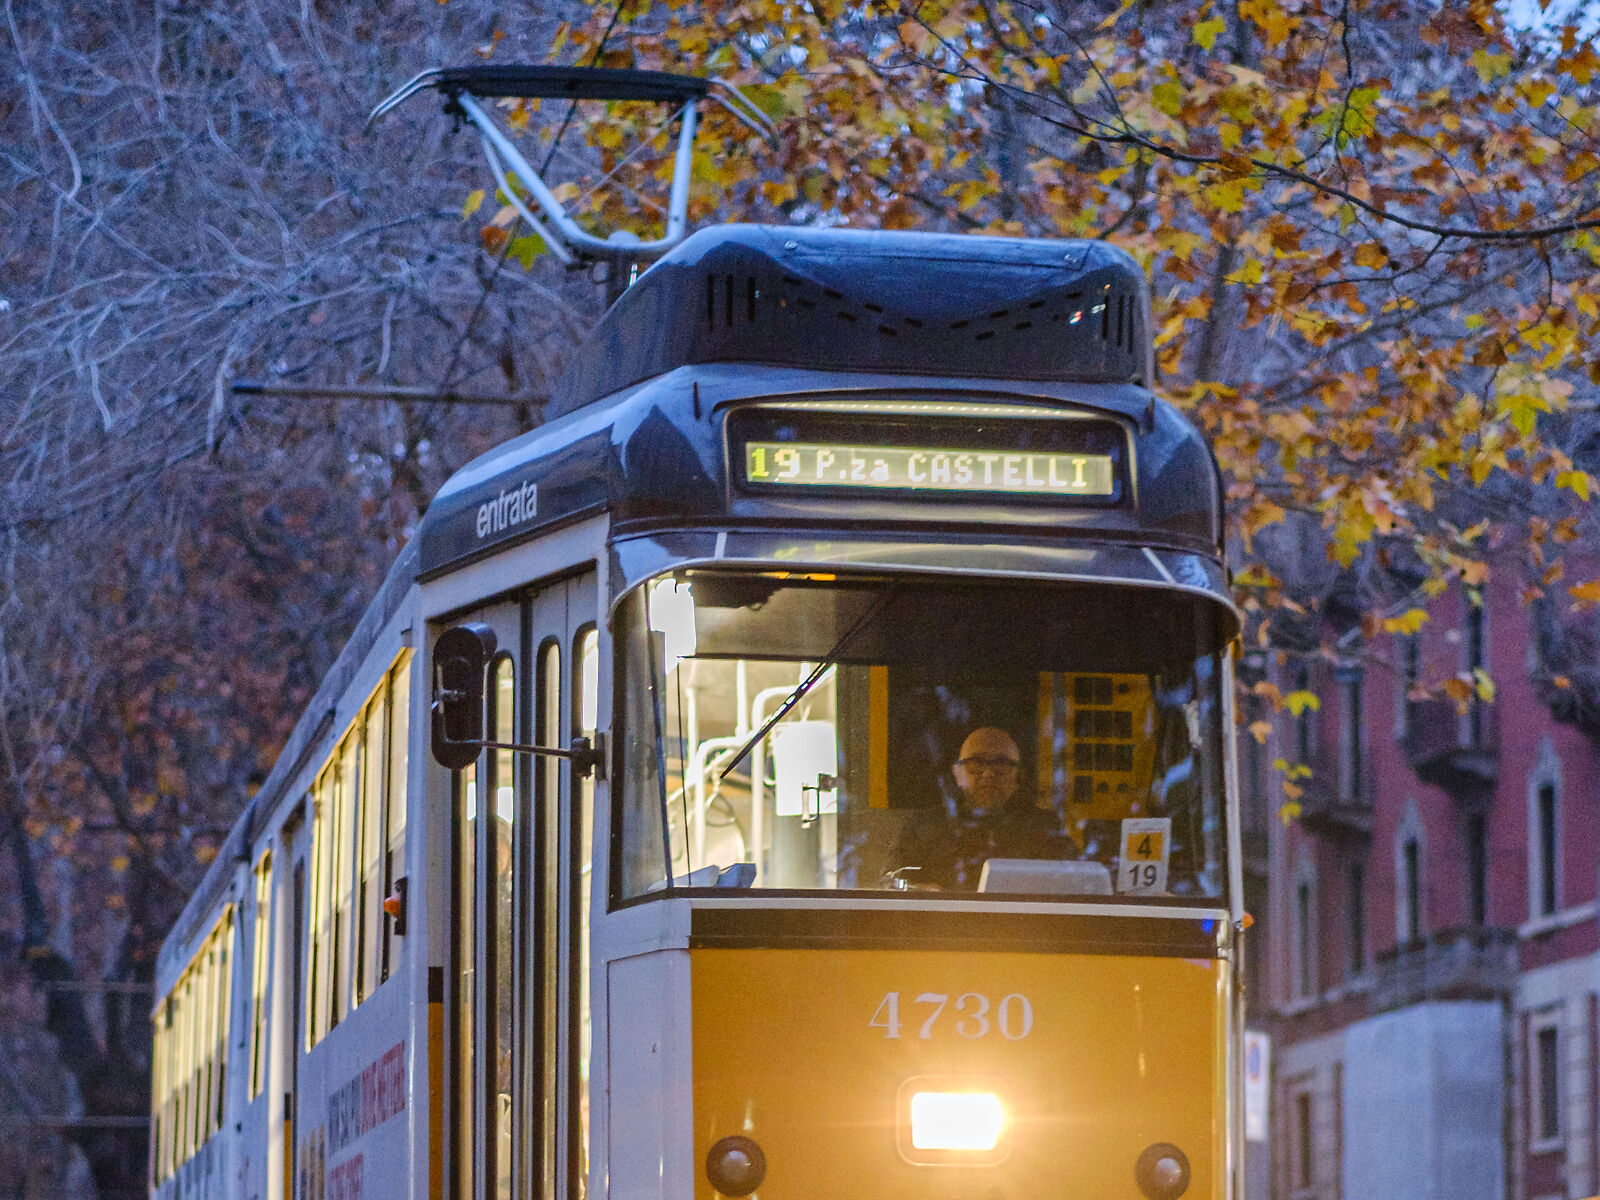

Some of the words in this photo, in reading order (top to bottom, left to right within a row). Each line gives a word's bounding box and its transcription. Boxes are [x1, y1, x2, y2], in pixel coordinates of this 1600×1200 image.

[751, 449, 800, 479] 19
[816, 450, 889, 481] P.za
[908, 453, 1087, 488] CASTELLI
[476, 480, 538, 538] entrata
[1137, 835, 1151, 858] 4
[1129, 864, 1157, 887] 19
[869, 992, 1034, 1040] 4730
